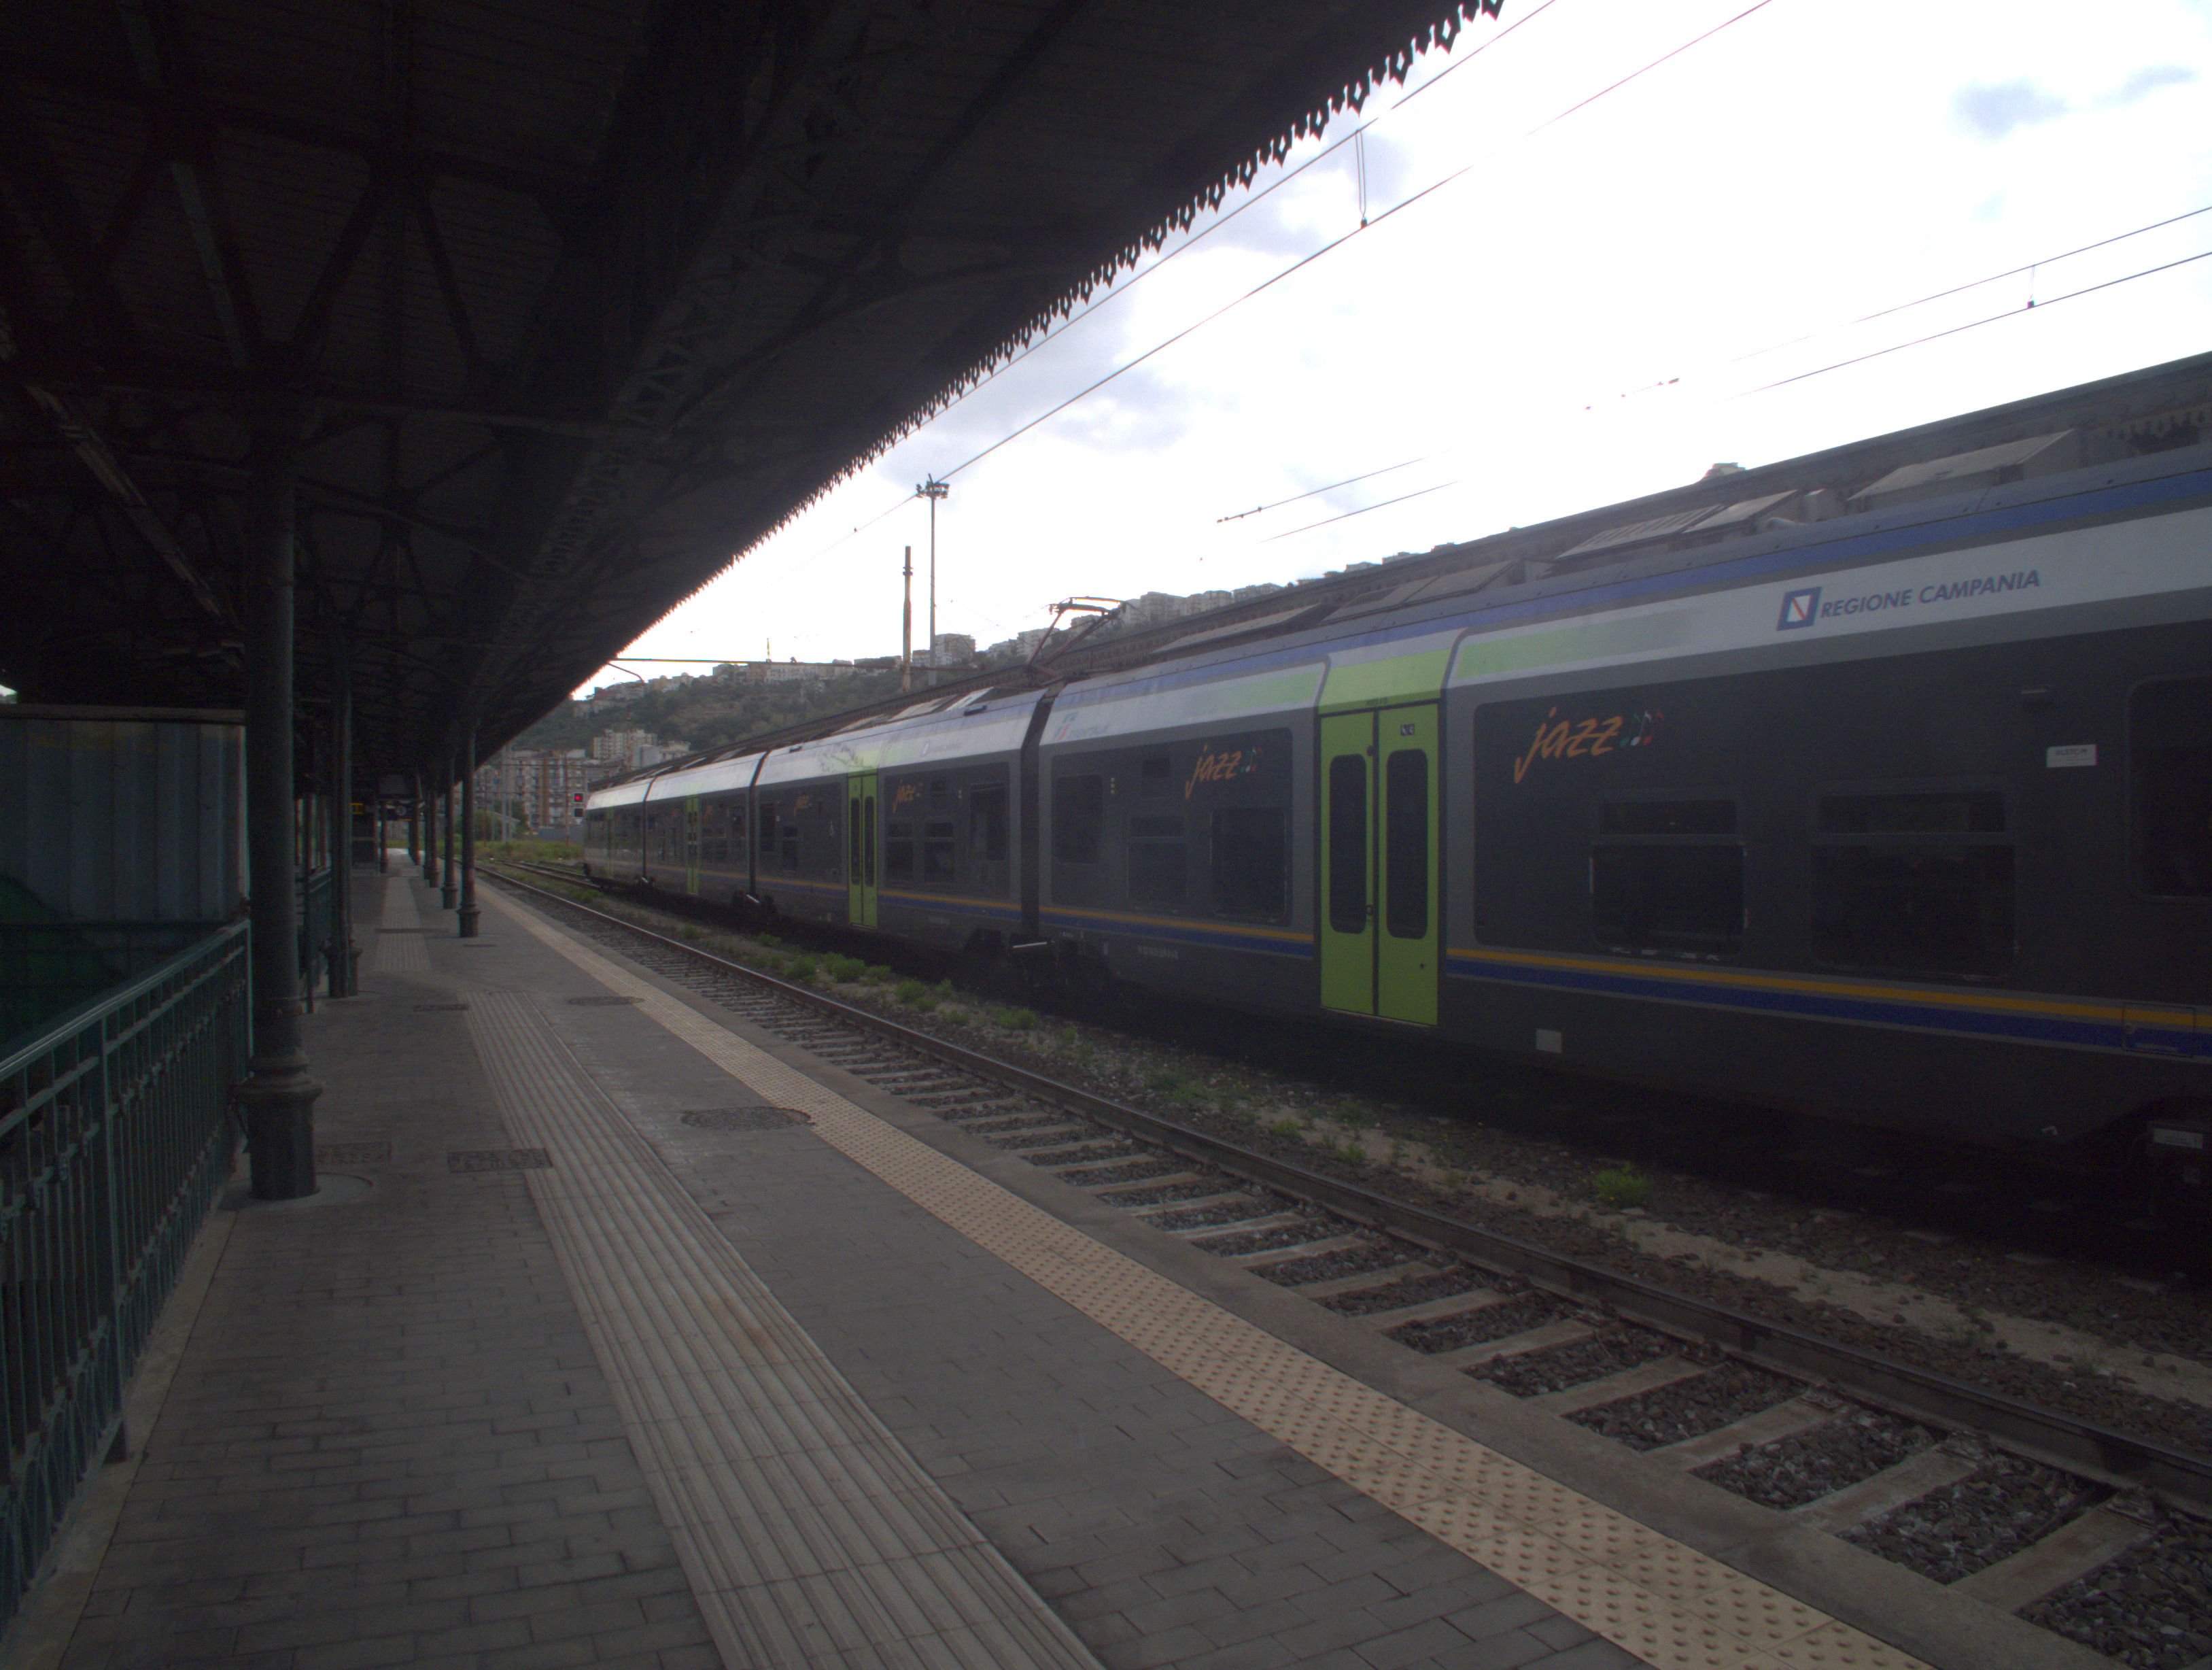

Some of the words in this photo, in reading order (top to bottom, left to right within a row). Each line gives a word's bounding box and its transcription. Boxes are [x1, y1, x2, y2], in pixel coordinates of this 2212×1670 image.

[1820, 589, 1913, 619] REGIONE
[1918, 569, 2041, 603] CAMPANIA
[1185, 743, 1243, 800] jazz
[1513, 706, 1624, 785] jazz
